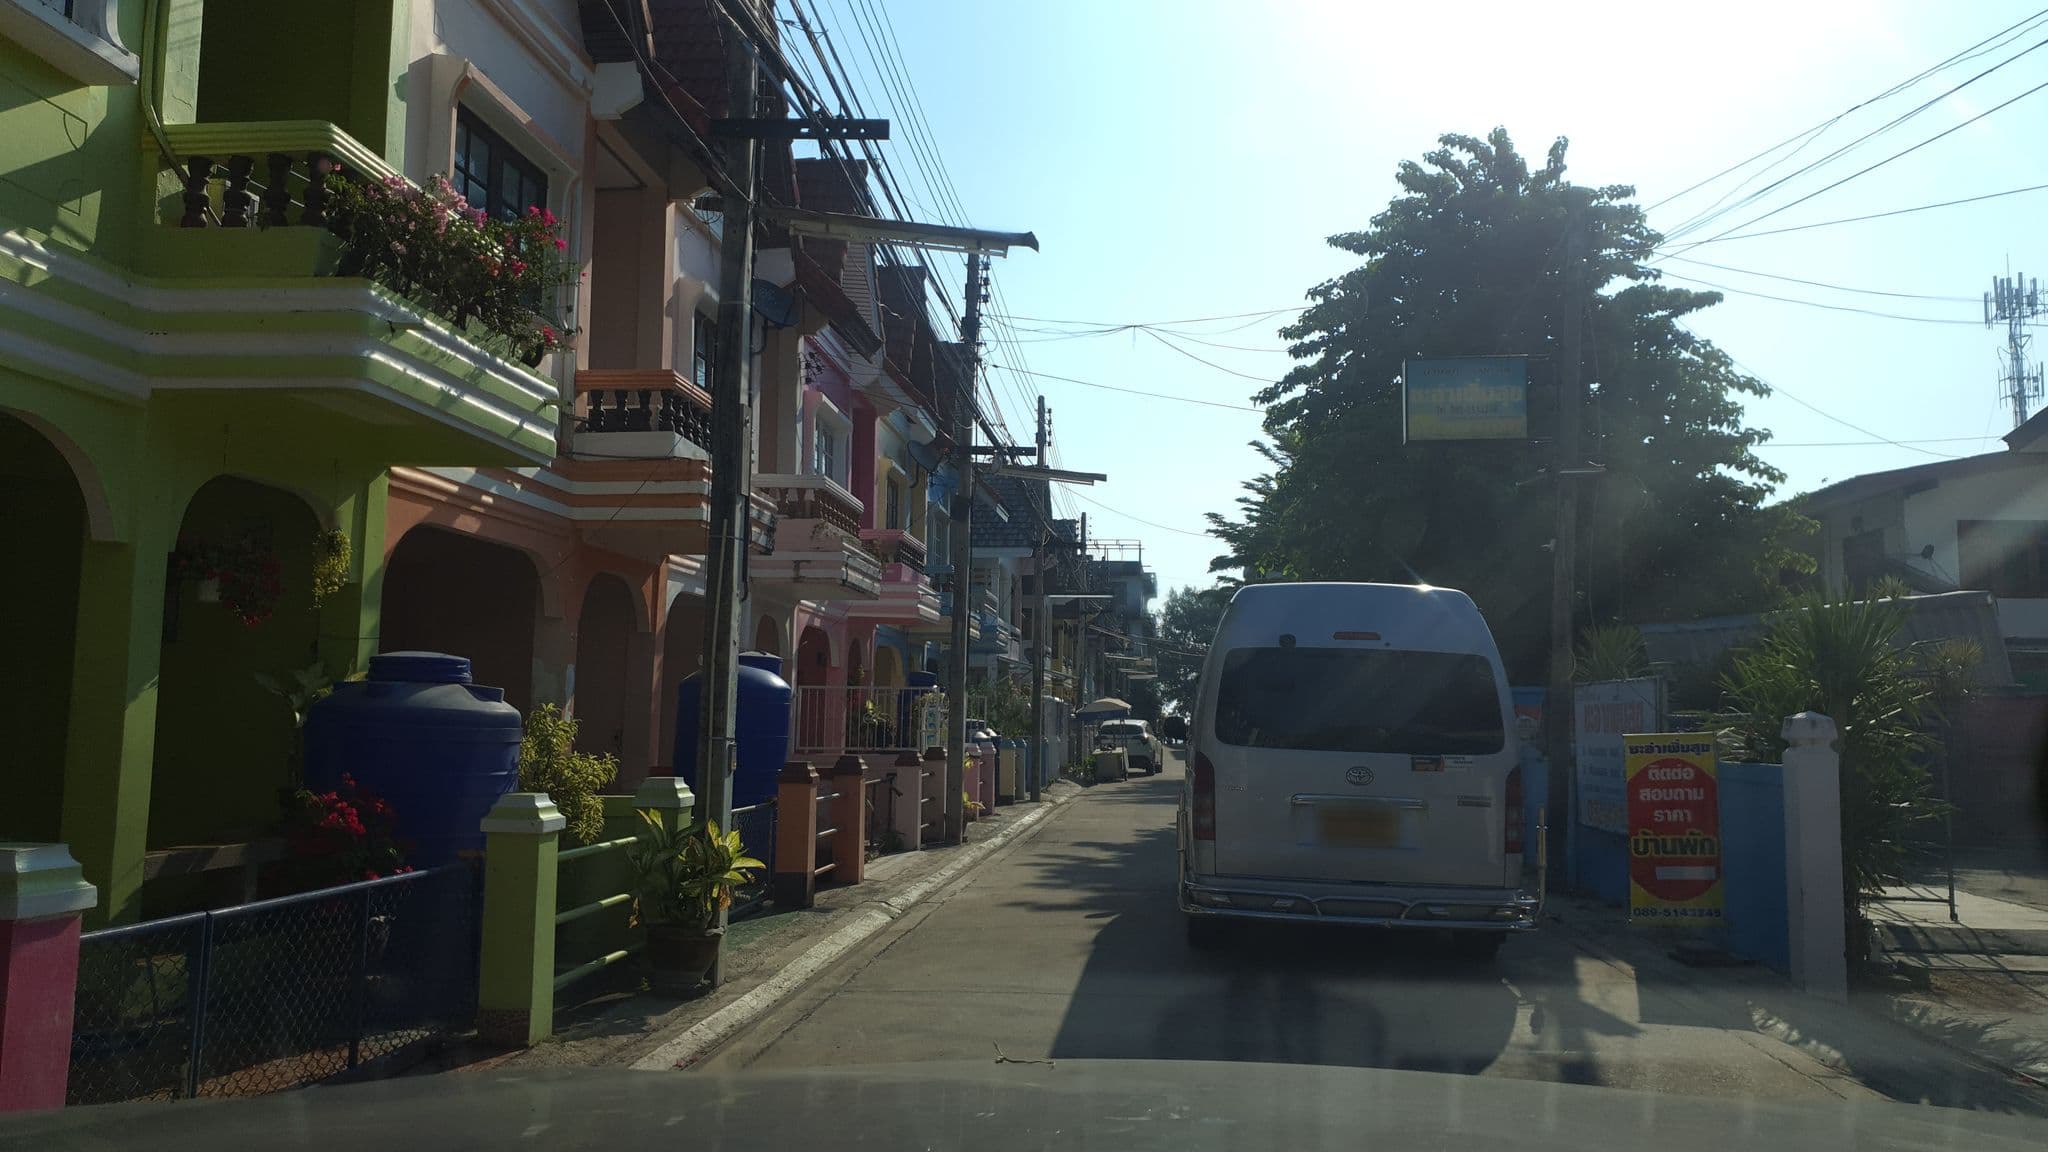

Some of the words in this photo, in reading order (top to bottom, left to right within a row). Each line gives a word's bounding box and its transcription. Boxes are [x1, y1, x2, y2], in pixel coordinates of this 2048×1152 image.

[1648, 763, 1694, 780] ติดต่อ
[1640, 788, 1704, 800] สอบถาม
[1654, 809, 1692, 822] ราคา
[1632, 829, 1717, 857] บ้านพัก
